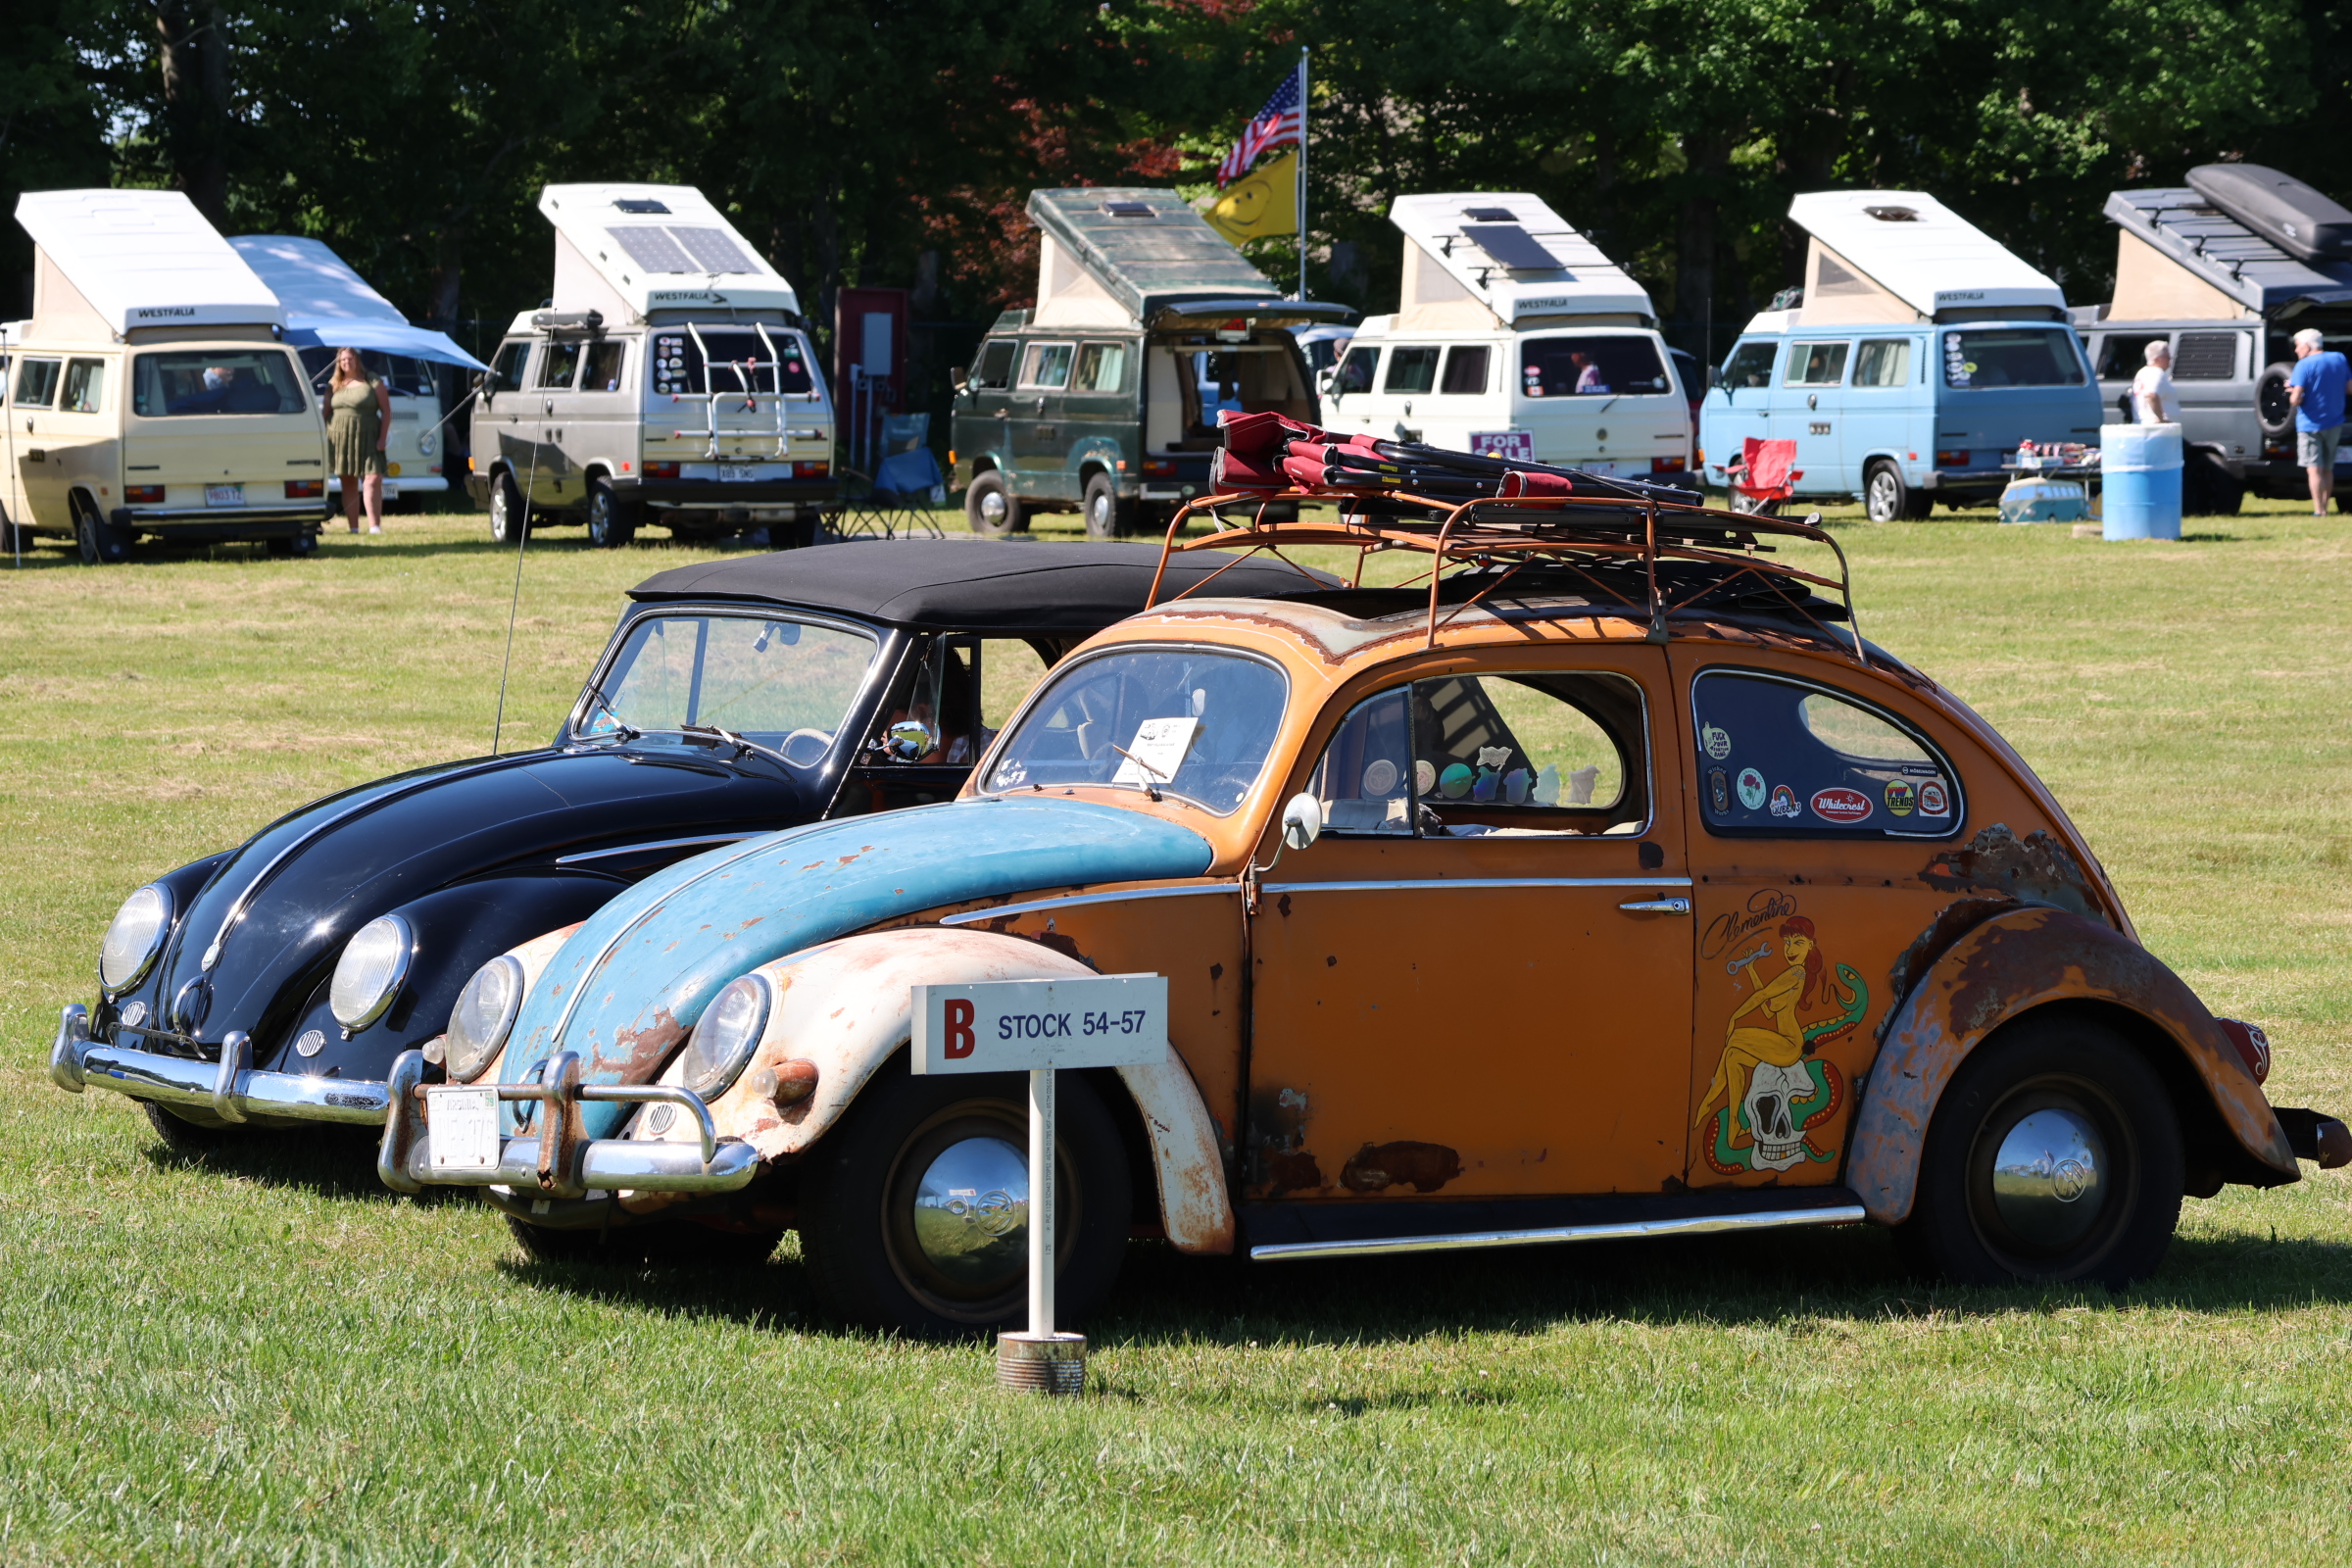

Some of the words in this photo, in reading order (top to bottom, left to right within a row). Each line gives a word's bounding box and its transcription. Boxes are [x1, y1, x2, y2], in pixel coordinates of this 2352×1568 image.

[655, 291, 709, 302] WESTFALIA
[1938, 292, 1984, 301] WESTFALIA
[1518, 299, 1567, 309] WESTFALIA
[138, 307, 195, 318] WESTFALIA
[1480, 435, 1522, 448] FOR
[1817, 797, 1866, 811] Whitecrest
[1887, 797, 1914, 808] TRENDS
[944, 998, 976, 1060] B
[998, 1012, 1072, 1040] STOCK
[1082, 1009, 1147, 1036] 54-57
